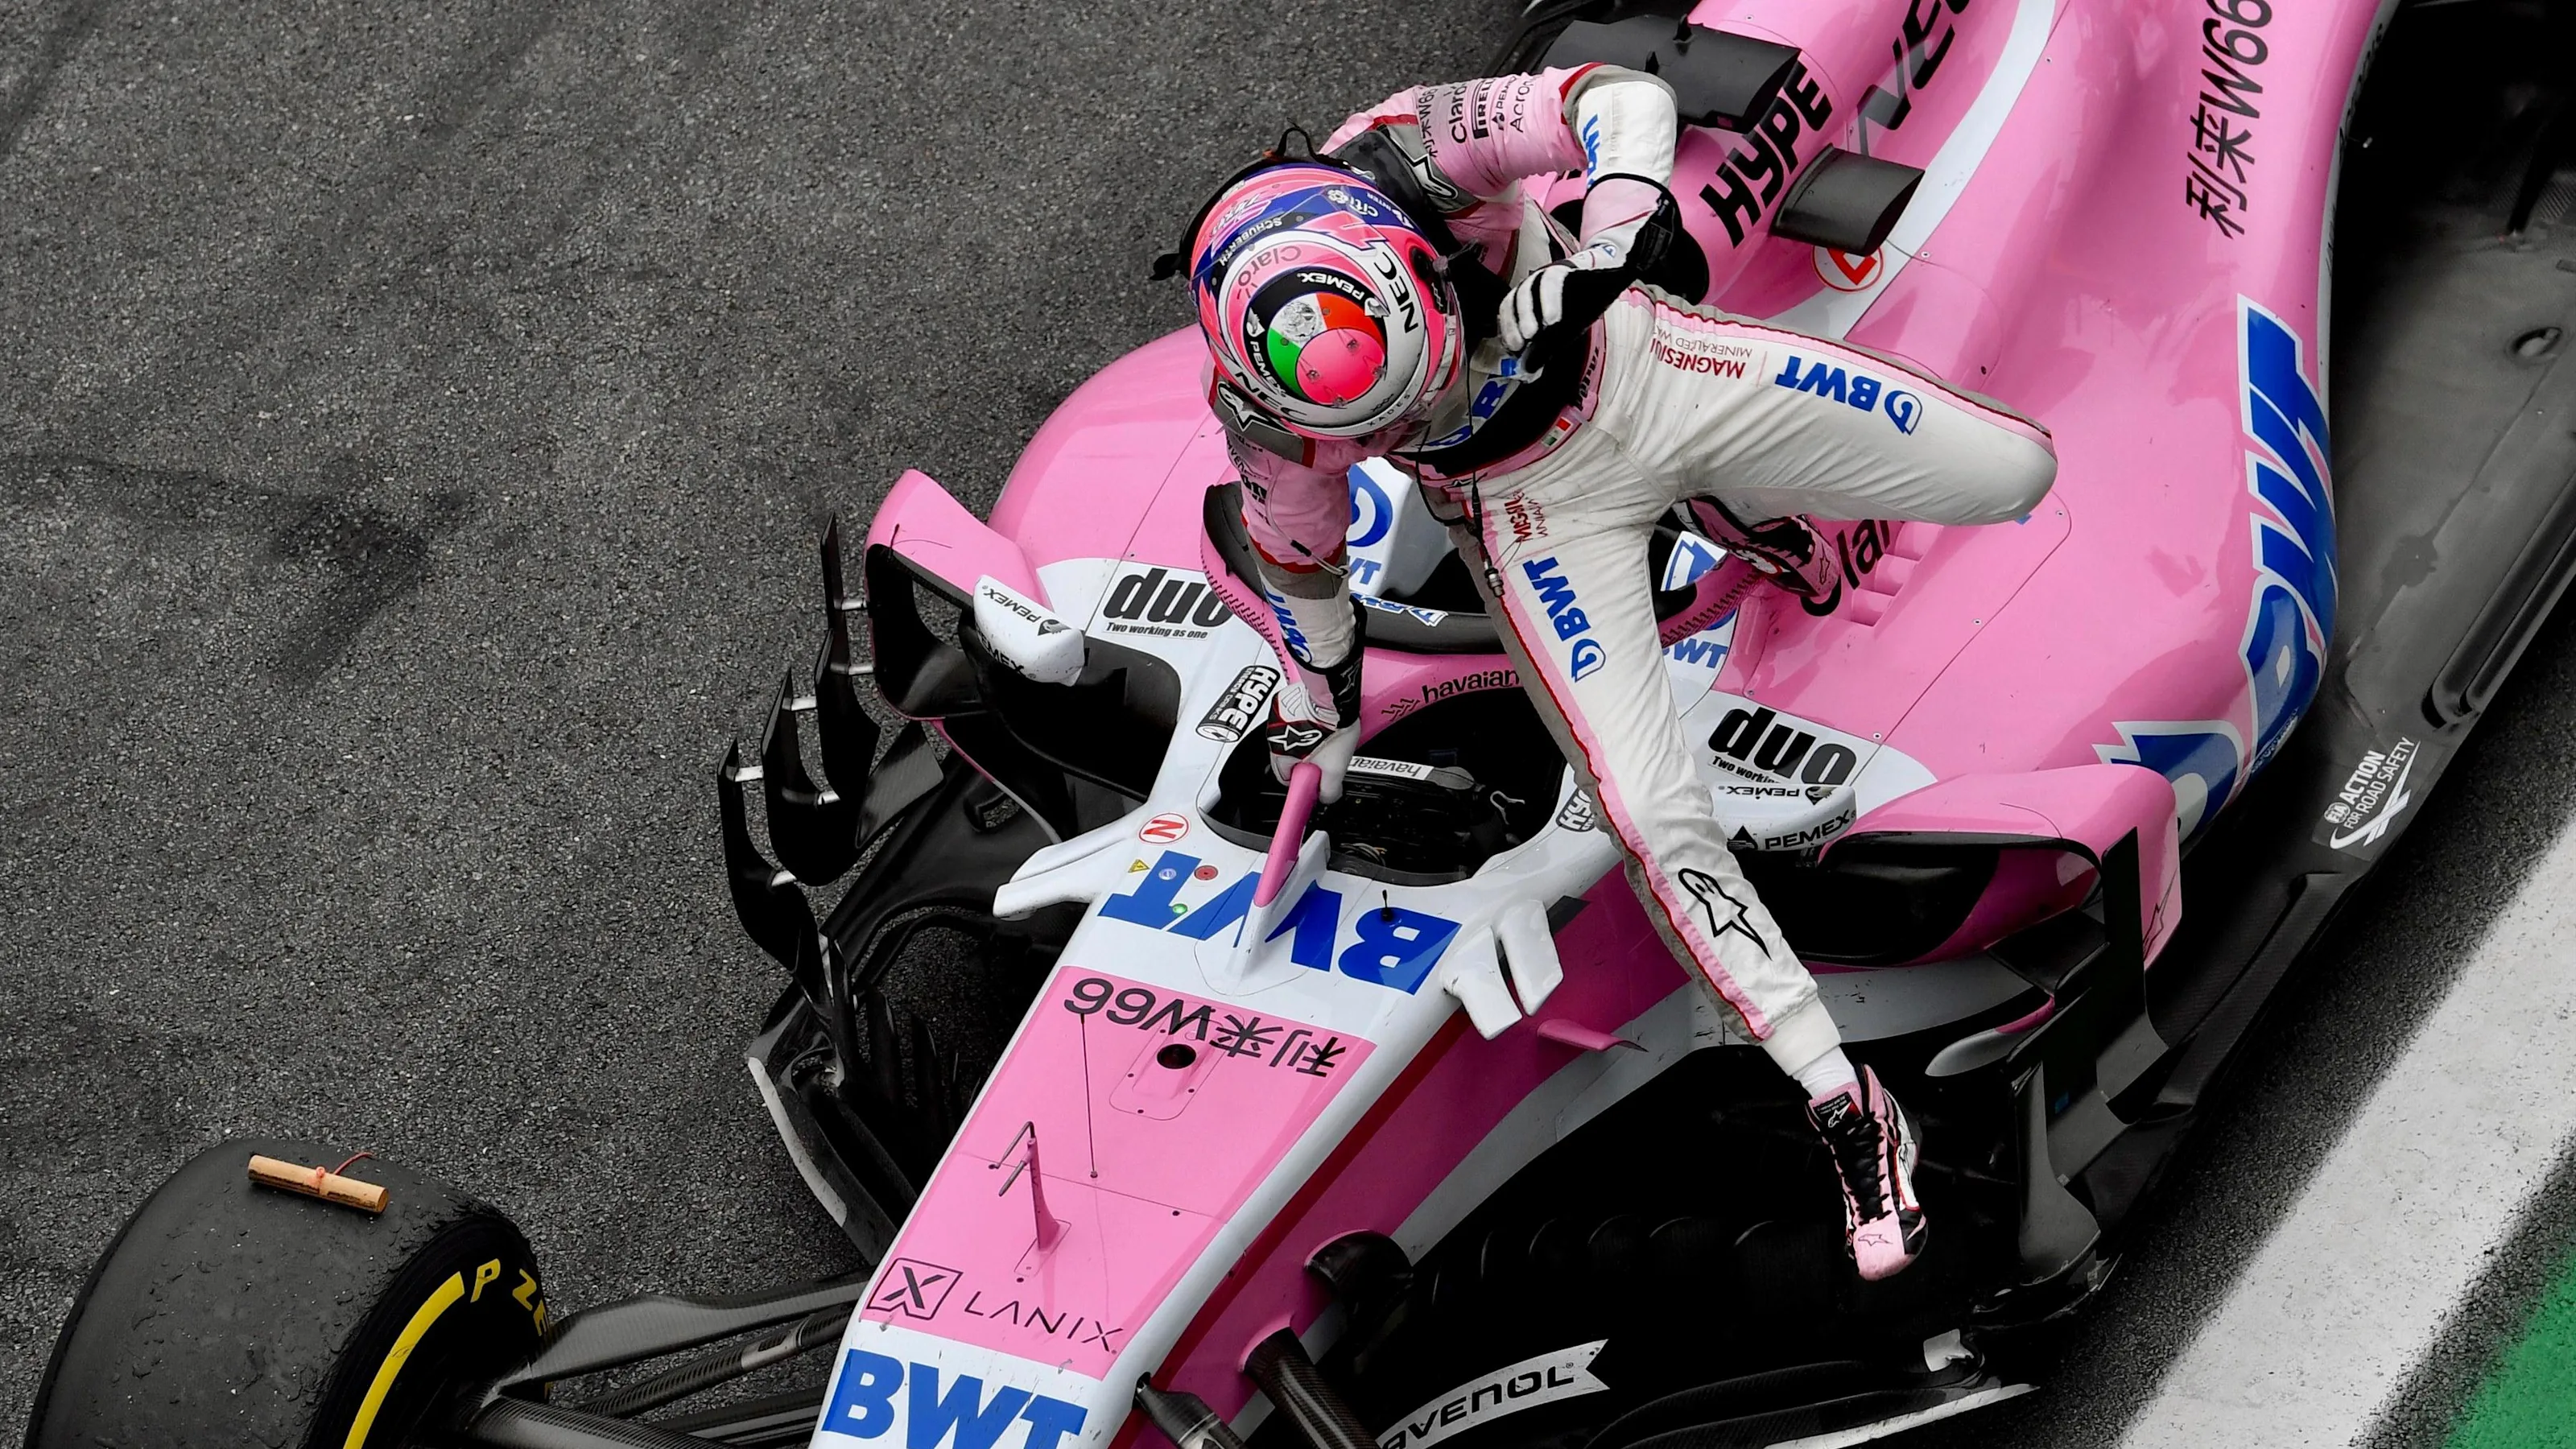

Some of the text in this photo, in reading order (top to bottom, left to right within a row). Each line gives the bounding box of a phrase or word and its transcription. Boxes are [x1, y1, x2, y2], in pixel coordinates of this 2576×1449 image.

[1857, 0, 1970, 157] NE
[1699, 60, 1833, 249] HYPE
[1219, 217, 1283, 268] SCHUBERTH
[1237, 245, 1302, 287] Claro
[1300, 272, 1365, 300] PEMEX
[1373, 251, 1419, 334] NEC
[1235, 372, 1308, 422] NEC
[1250, 341, 1284, 397] PEMEX
[1774, 355, 1882, 412] BWT
[983, 588, 1042, 622] PEMEX
[1103, 568, 1234, 628] duo
[1522, 555, 1591, 642] BWT
[1106, 621, 1208, 639] Two working as one
[1663, 638, 1728, 670] WT
[1217, 667, 1278, 731] HYPE
[1422, 668, 1520, 704] havaian
[1707, 706, 1857, 786] duo
[1712, 755, 1736, 772] Two
[1726, 785, 1800, 797] PEMEX
[2339, 749, 2387, 806] ACTION
[2343, 736, 2415, 830] FOR ROAD SAFETY
[1765, 809, 1850, 850] PEMEX
[1096, 849, 1463, 995] BWT
[1063, 976, 1347, 1079] 利来W66
[964, 1290, 1124, 1352] LANIX
[821, 1348, 1089, 1449] BWT
[1381, 1365, 1575, 1449] AVENOL
